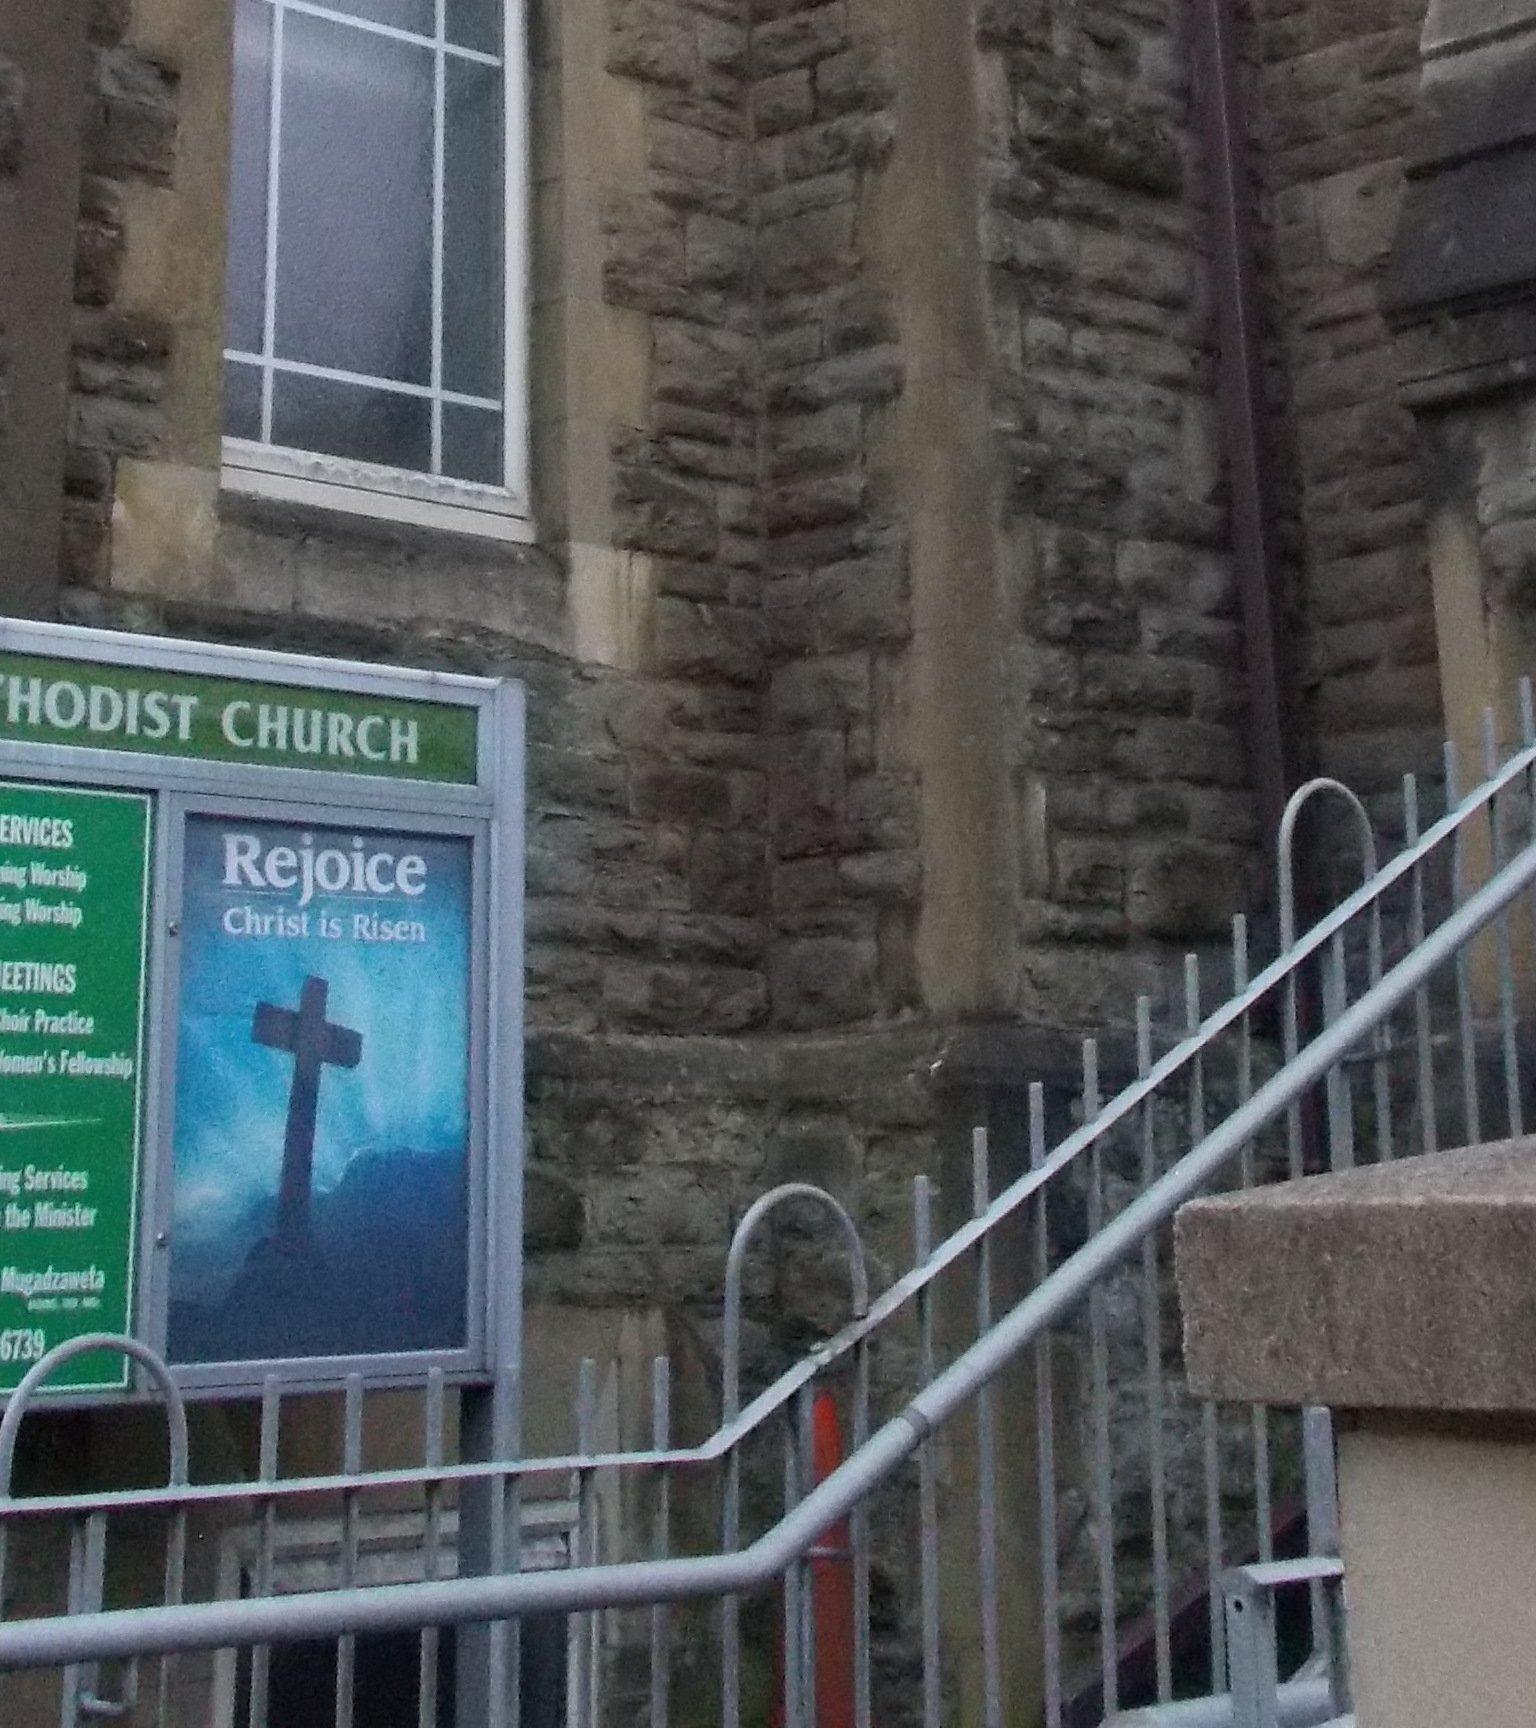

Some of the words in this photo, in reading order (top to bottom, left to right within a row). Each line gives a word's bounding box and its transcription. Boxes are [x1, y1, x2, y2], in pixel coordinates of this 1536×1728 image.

[221, 700, 419, 765] CHURCH
[29, 861, 87, 892] Worship
[222, 832, 427, 906] Rejoice
[24, 898, 83, 928] Worship
[223, 906, 309, 937] Christ
[320, 910, 343, 939] is
[353, 912, 426, 942] Risen
[35, 1008, 95, 1035] Practice
[60, 1049, 133, 1080] Fellowship
[24, 1164, 89, 1192] Services
[4, 1202, 31, 1229] the
[33, 1201, 97, 1228] Minister
